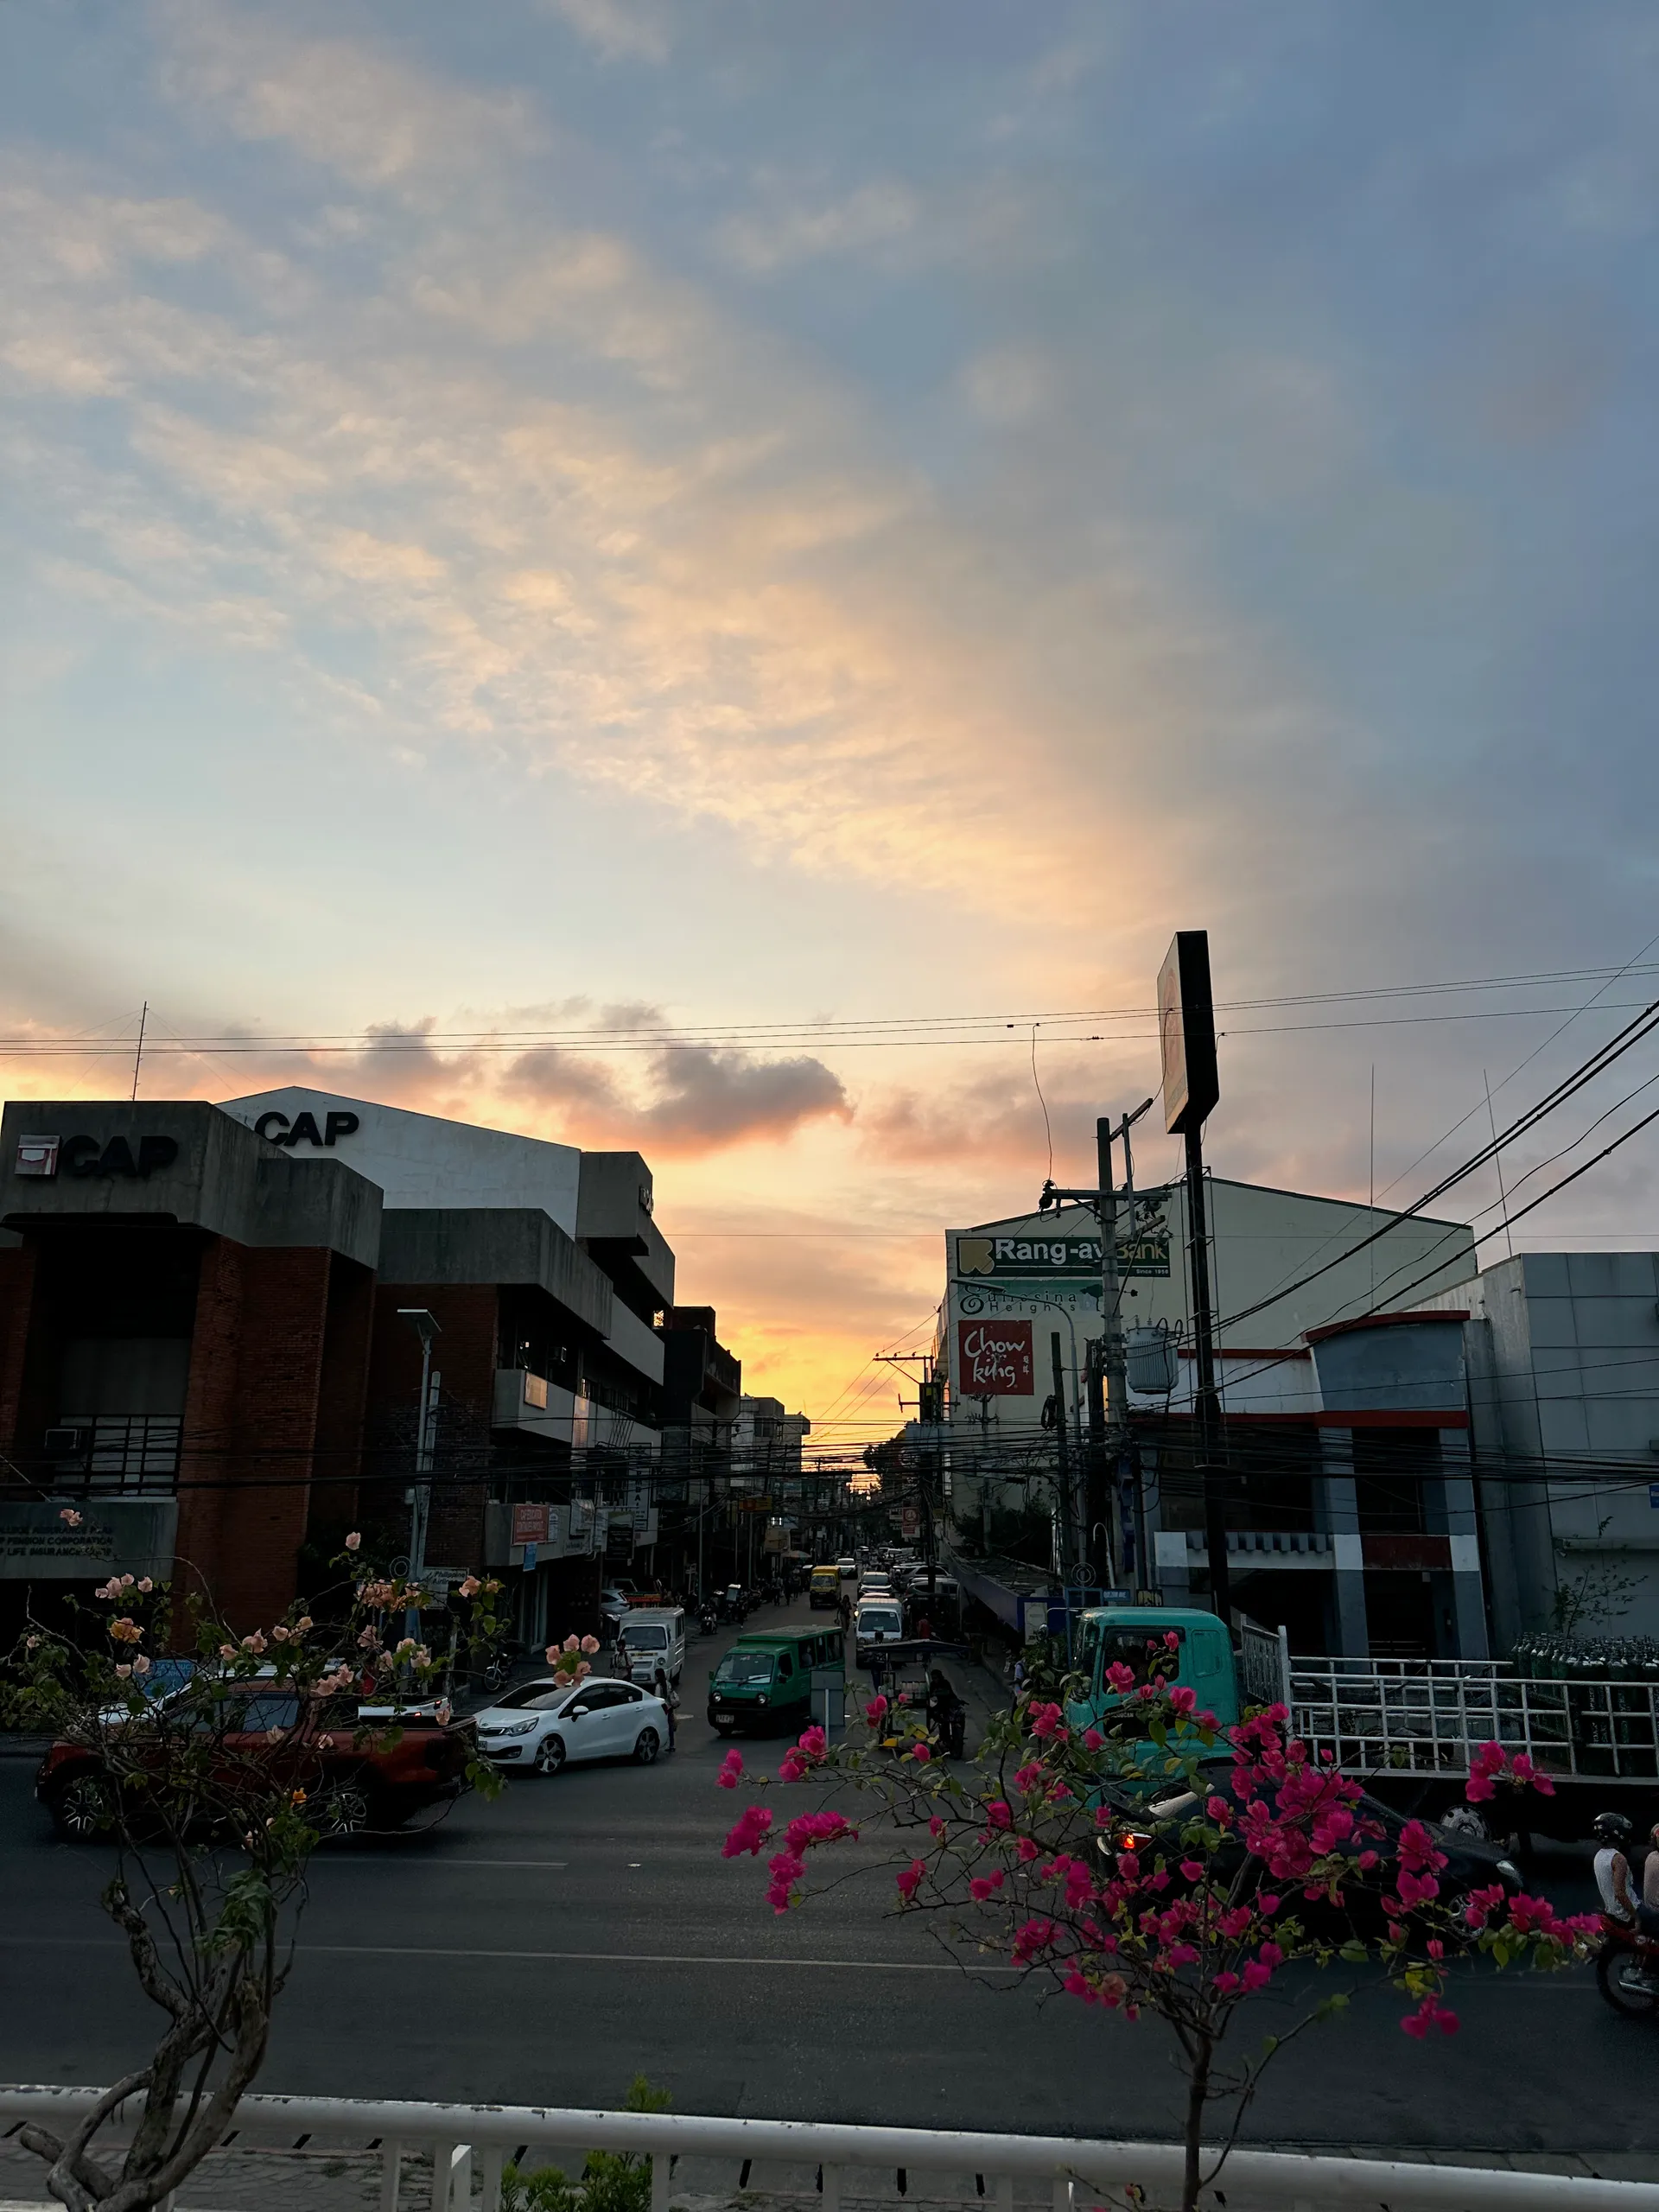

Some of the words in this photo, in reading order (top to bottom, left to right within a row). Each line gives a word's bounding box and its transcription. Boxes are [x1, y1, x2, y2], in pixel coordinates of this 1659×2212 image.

[254, 1111, 359, 1146] CAP
[60, 1135, 179, 1178] CAP
[964, 1326, 1026, 1357] Chow
[973, 1357, 1016, 1389] king
[7, 1536, 45, 1545] PENSION
[47, 1536, 113, 1545] CORPORATION
[7, 1548, 27, 1556] LIFE
